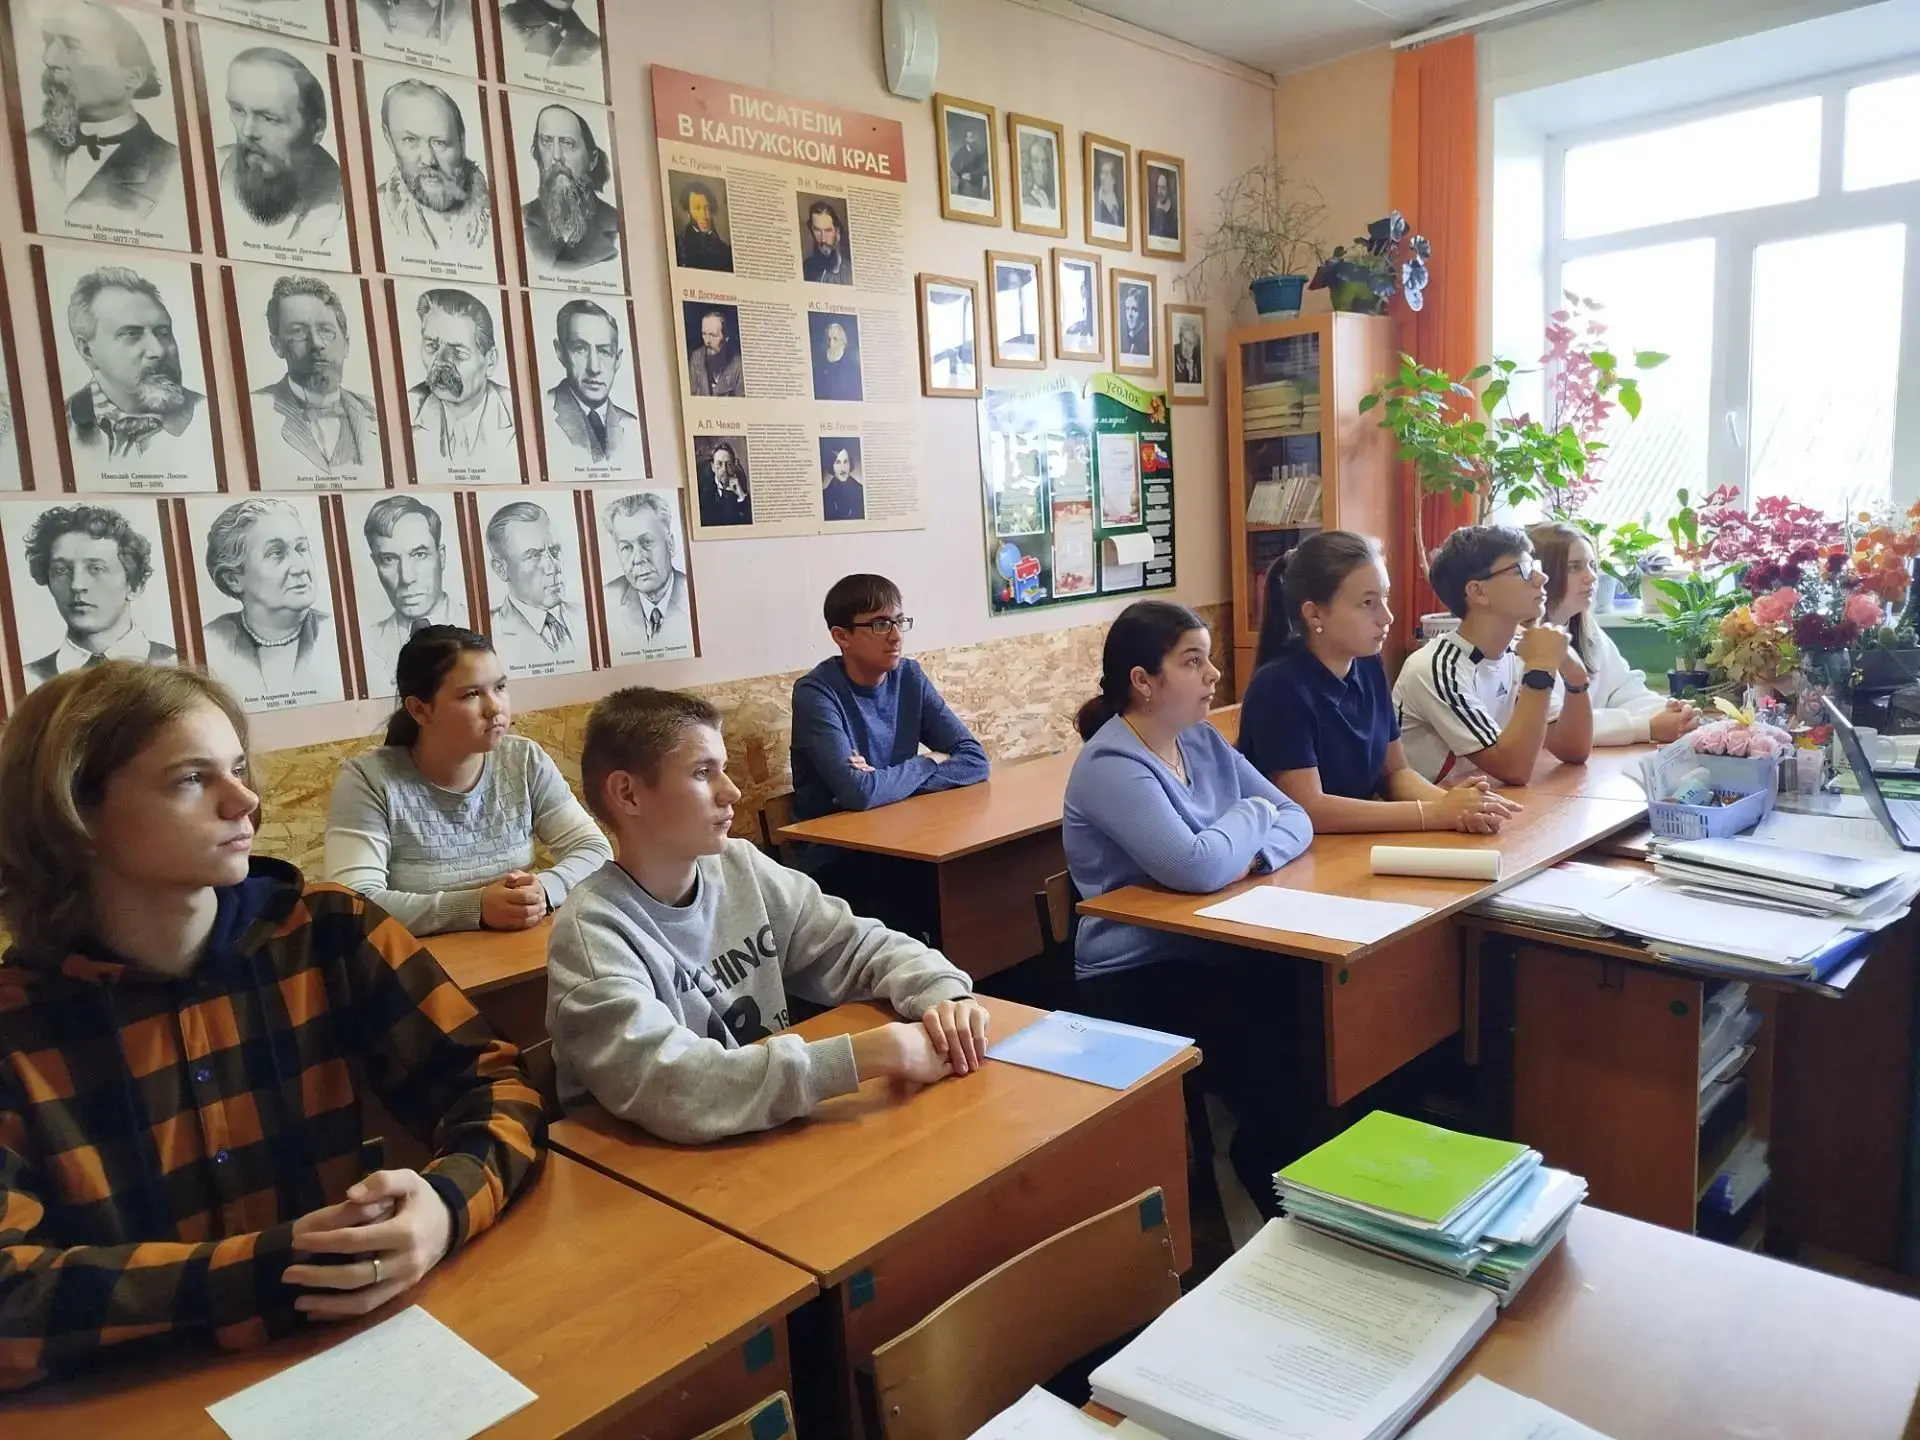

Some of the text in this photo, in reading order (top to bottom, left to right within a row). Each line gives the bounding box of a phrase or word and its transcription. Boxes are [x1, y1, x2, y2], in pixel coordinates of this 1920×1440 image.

[729, 93, 843, 137] ПИСАТЕЛИ
[677, 113, 892, 175] В КАЛУЖСКОМ КРАЕ
[697, 419, 741, 430] А.П. Чехов
